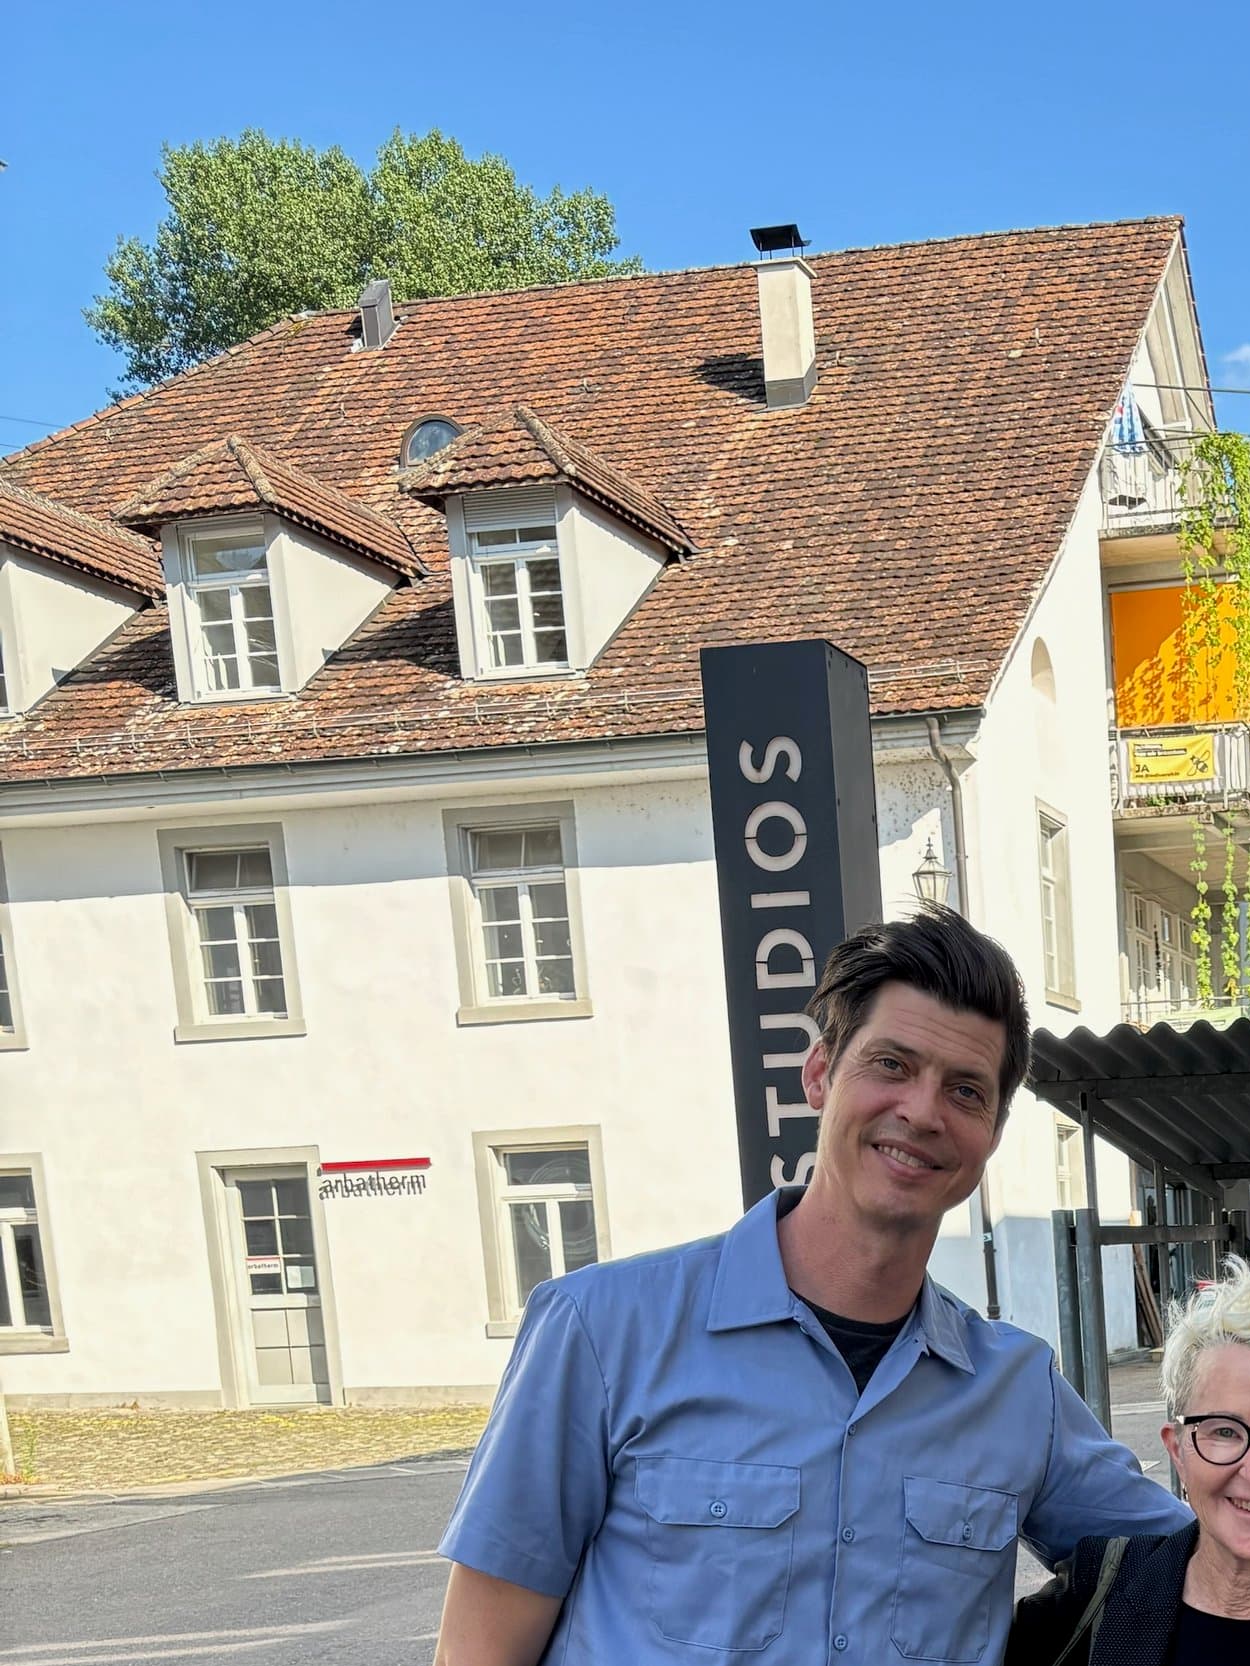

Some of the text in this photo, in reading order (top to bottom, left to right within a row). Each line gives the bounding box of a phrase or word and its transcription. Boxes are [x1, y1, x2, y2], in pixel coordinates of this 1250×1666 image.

[1135, 764, 1149, 773] JA
[739, 736, 822, 1188] STUDIOS
[321, 1170, 426, 1193] arbatherm
